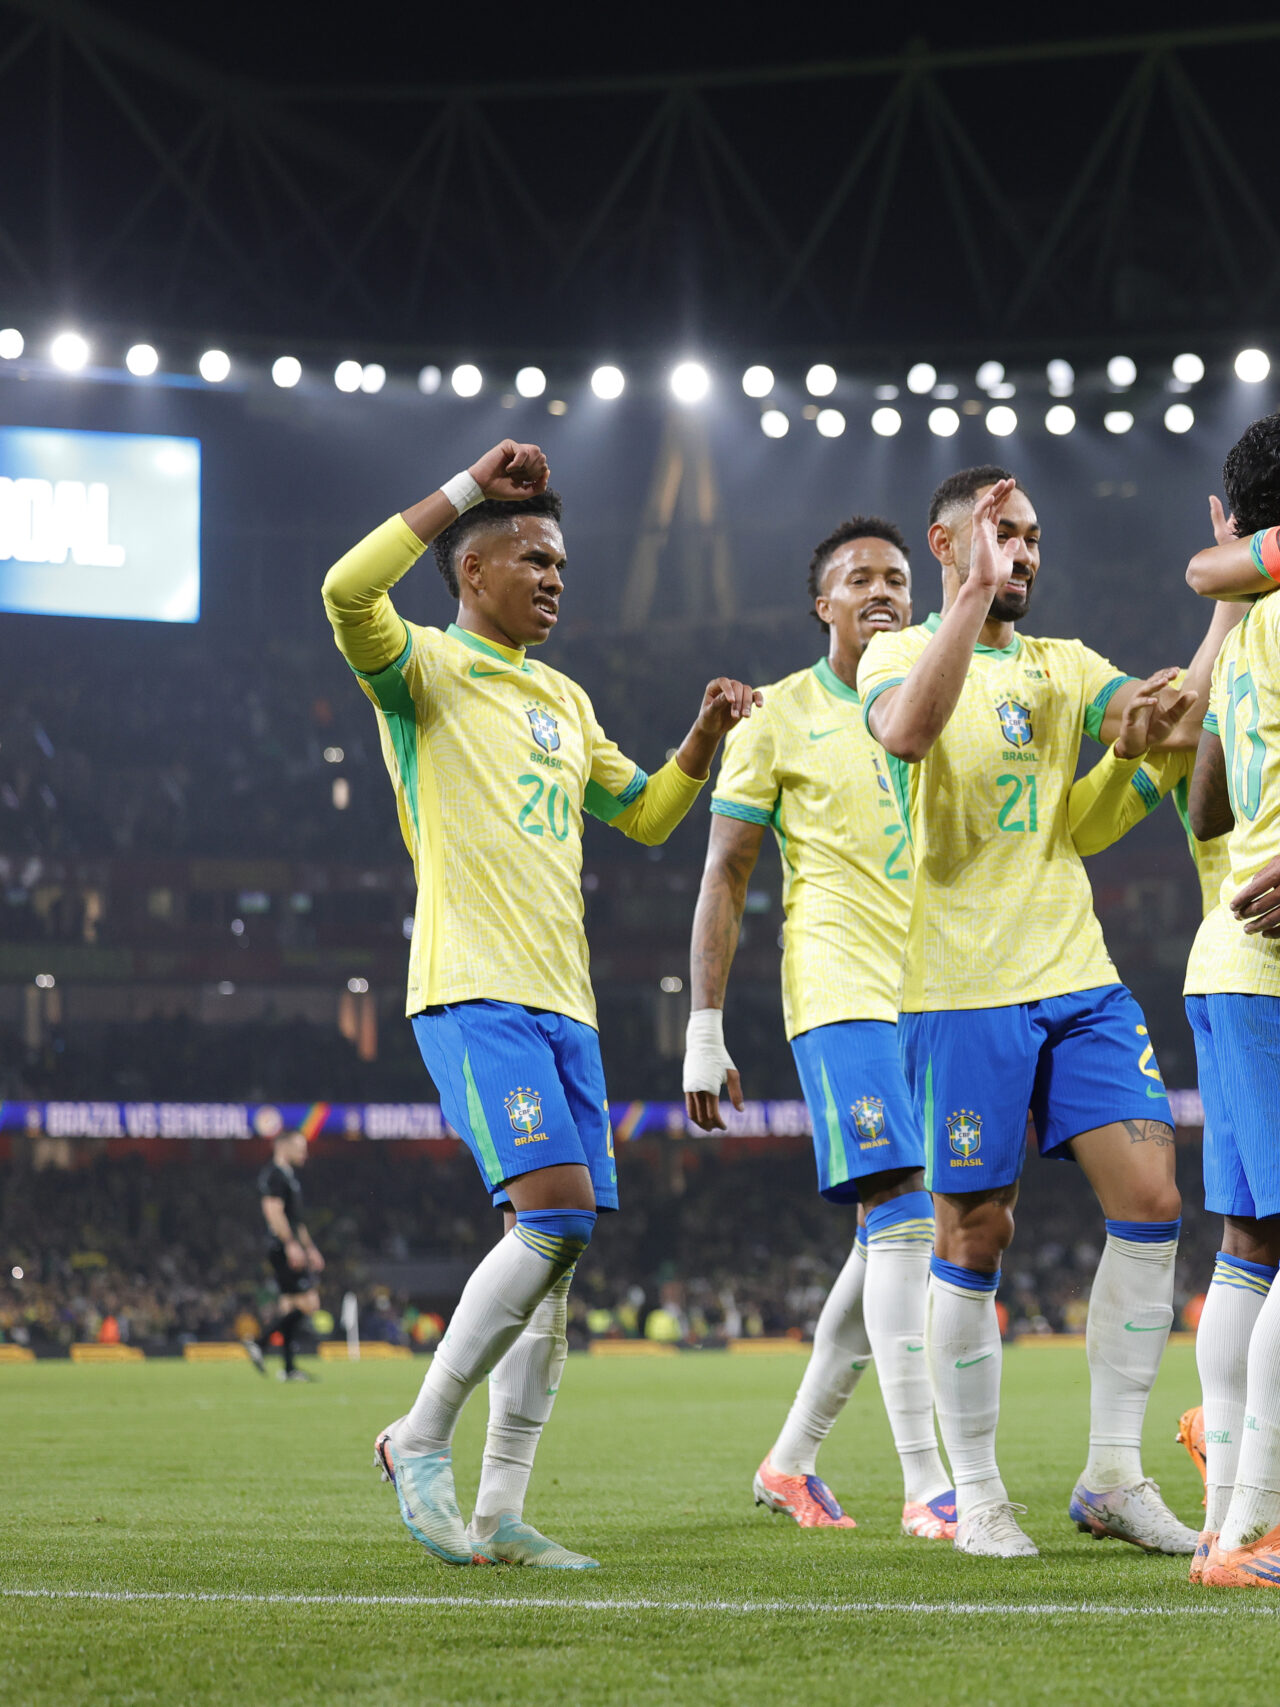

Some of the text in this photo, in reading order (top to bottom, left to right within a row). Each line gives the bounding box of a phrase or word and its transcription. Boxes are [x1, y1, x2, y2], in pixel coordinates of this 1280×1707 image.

[530, 752, 562, 770] BRASIL
[1002, 751, 1039, 763] BRASIL
[518, 774, 569, 842] 20
[996, 774, 1038, 832] 21
[514, 1132, 550, 1147] BRASIL
[860, 1138, 890, 1150] BRASIL
[950, 1157, 984, 1167] BRASIL
